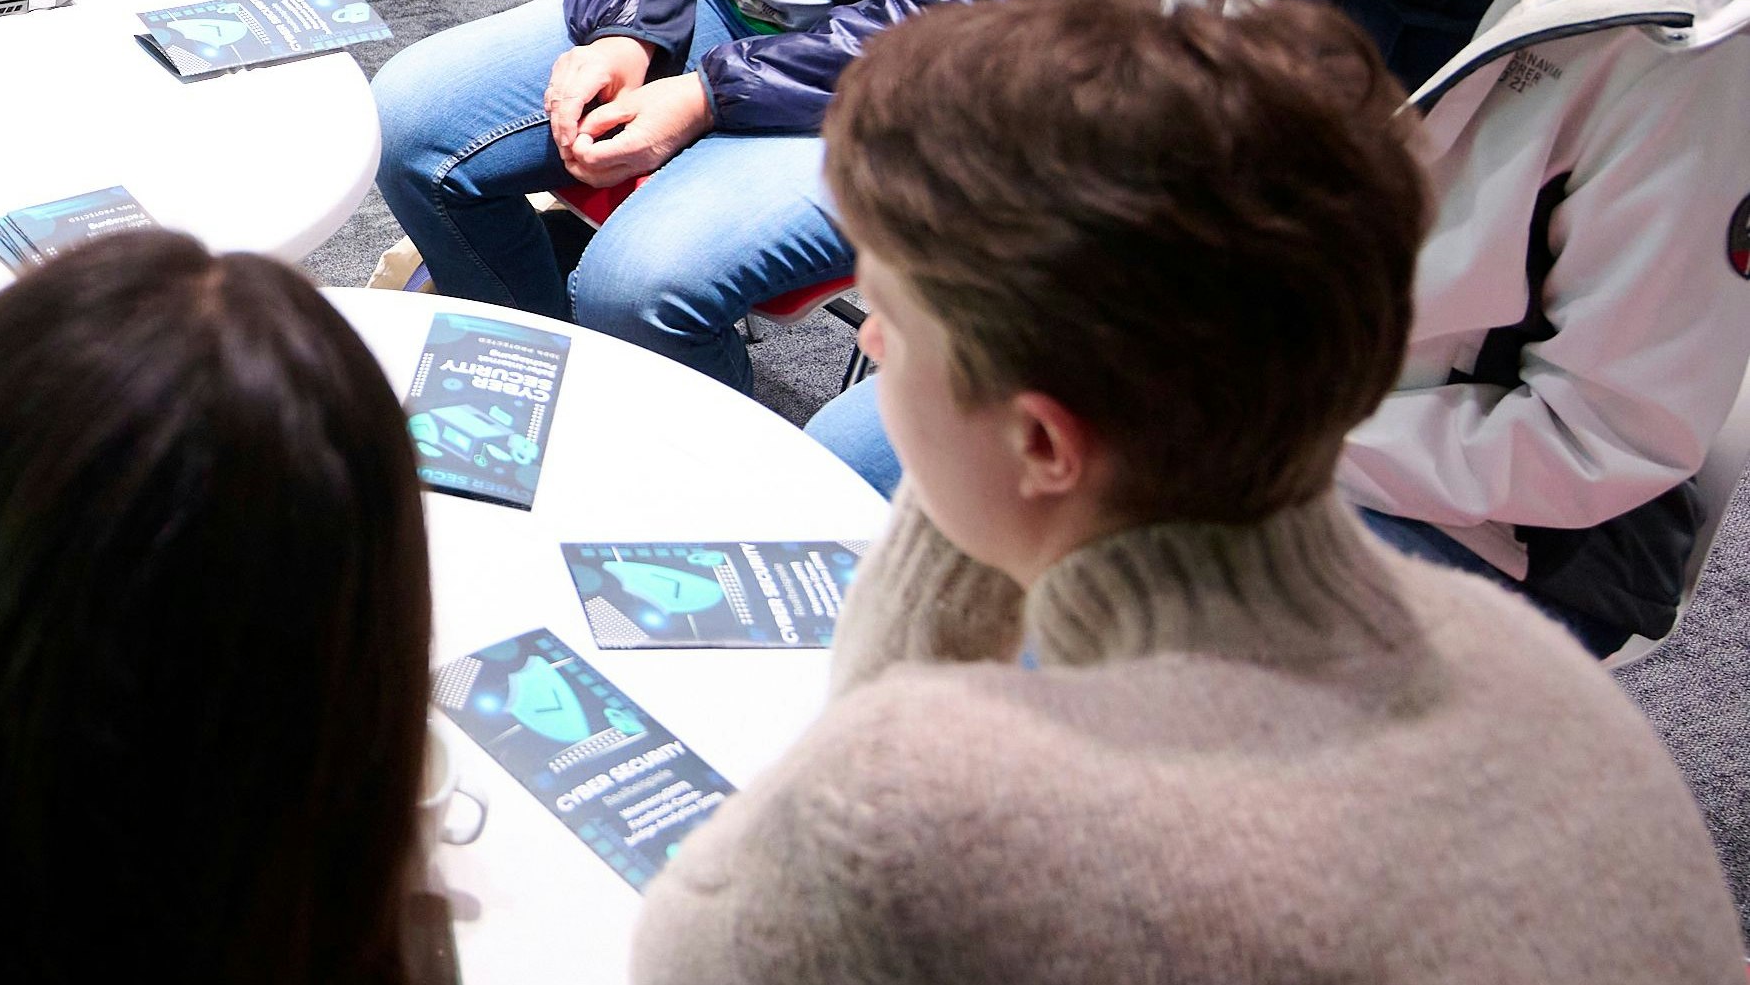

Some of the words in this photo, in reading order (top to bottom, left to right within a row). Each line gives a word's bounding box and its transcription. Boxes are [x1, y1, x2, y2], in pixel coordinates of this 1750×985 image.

[440, 360, 553, 391] SECURITY
[471, 376, 550, 402] CYBER
[422, 469, 468, 485] SECU
[740, 543, 780, 596] SECURITY
[767, 598, 800, 643] CYBER
[556, 774, 611, 813] CYBER
[609, 740, 685, 782] SECURITY
